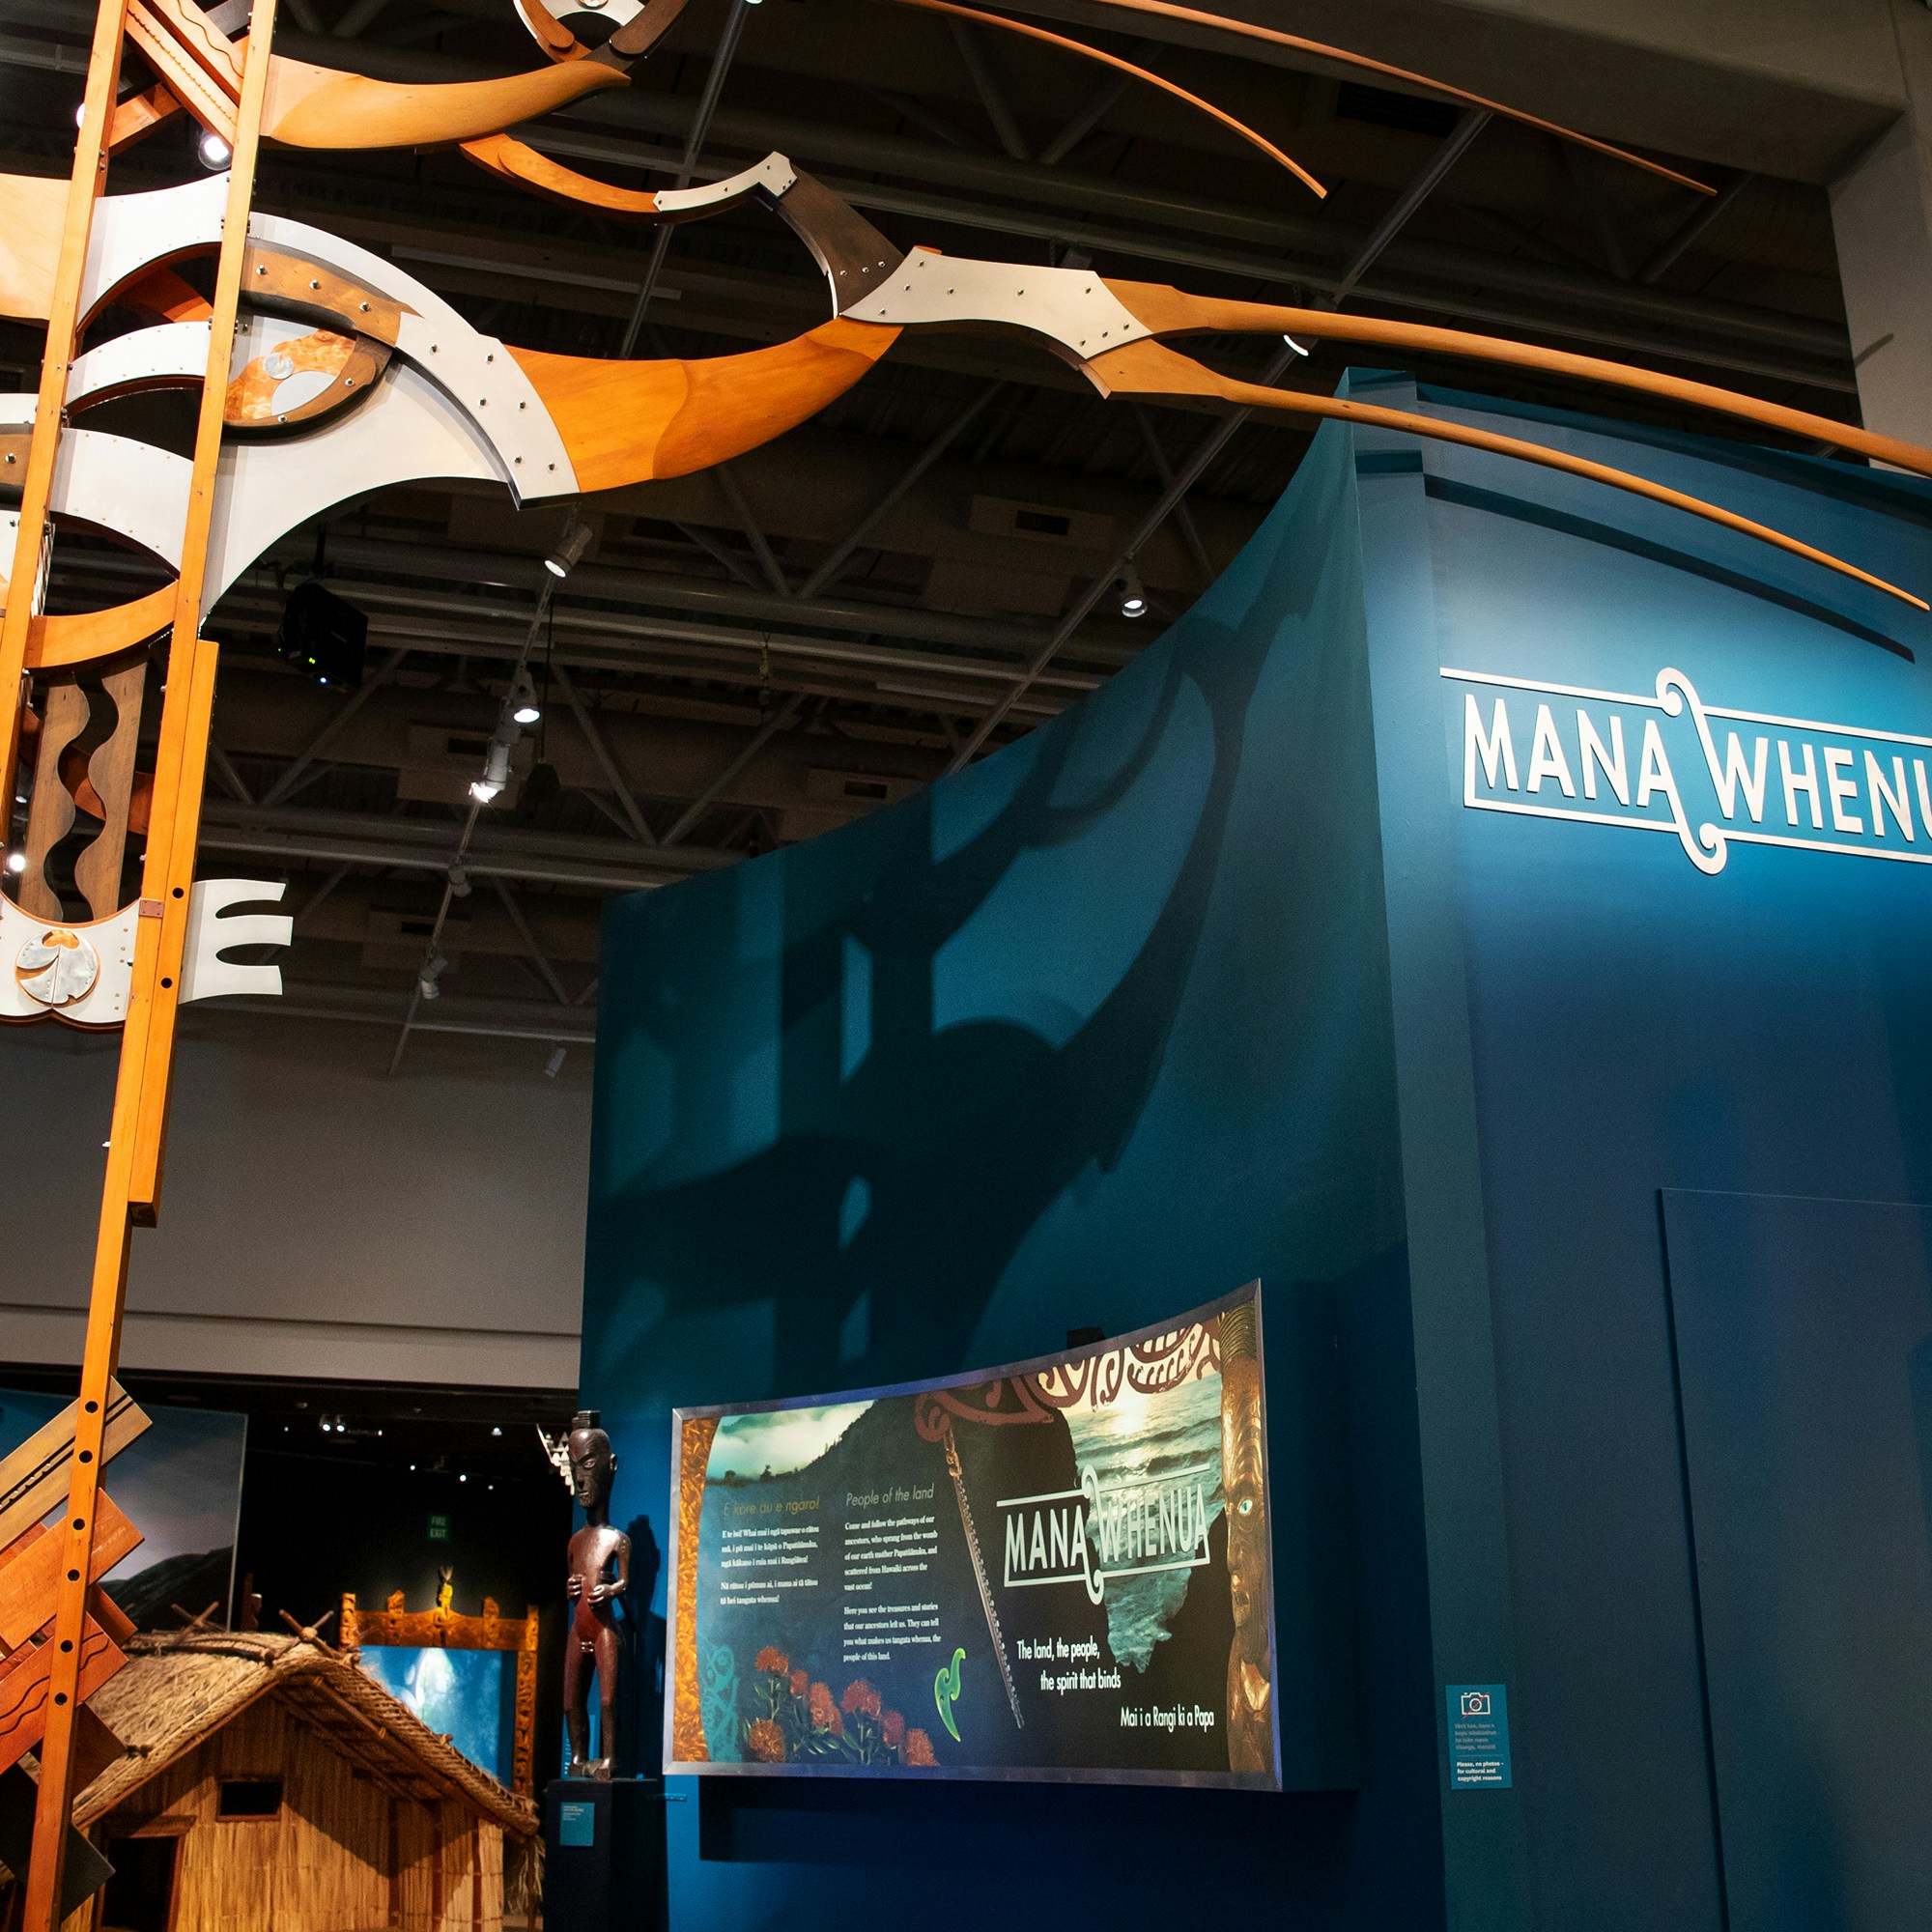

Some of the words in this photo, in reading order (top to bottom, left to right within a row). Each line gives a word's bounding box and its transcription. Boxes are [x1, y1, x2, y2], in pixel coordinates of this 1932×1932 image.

[1463, 692, 1681, 813] MANA
[846, 1490, 879, 1509] People
[882, 1487, 893, 1503] of
[895, 1487, 909, 1502] the
[912, 1483, 935, 1500] land
[734, 1500, 756, 1516] kore
[759, 1505, 773, 1514] au
[776, 1503, 782, 1513] e
[845, 1522, 861, 1530] Come
[861, 1520, 871, 1529] and
[871, 1520, 886, 1528] follow
[887, 1519, 896, 1527] the
[896, 1517, 919, 1527] pathways
[919, 1515, 926, 1524] of
[871, 1535, 882, 1543] who
[883, 1535, 900, 1544] sprang
[900, 1533, 913, 1541] from
[913, 1532, 922, 1540] the
[922, 1530, 938, 1539] womb
[1004, 1504, 1088, 1580] MANA
[1097, 1483, 1210, 1565] WHENUA
[844, 1552, 851, 1560] of
[860, 1551, 874, 1560] earth
[875, 1550, 894, 1558] mother
[928, 1546, 938, 1554] and
[844, 1566, 868, 1576] scattered
[868, 1566, 881, 1574] from
[881, 1564, 902, 1573] Hawaiki
[919, 1562, 928, 1570] the
[855, 1582, 872, 1590] ocean!
[844, 1606, 857, 1615] Here
[858, 1607, 868, 1615] you
[878, 1604, 887, 1613] the
[911, 1603, 921, 1611] and
[921, 1602, 938, 1611] stories
[844, 1622, 854, 1630] that
[865, 1621, 889, 1630] ancestors
[889, 1620, 898, 1628] left
[907, 1619, 920, 1628] They
[930, 1618, 939, 1626] tell
[854, 1637, 867, 1645] what
[867, 1636, 884, 1645] makes
[892, 1636, 911, 1645] tangata
[911, 1634, 932, 1643] whenua,
[932, 1634, 942, 1642] the
[1016, 1640, 1033, 1660] The
[1034, 1637, 1055, 1662] land,
[1056, 1636, 1069, 1659] the
[1070, 1634, 1100, 1663] people,
[843, 1652, 861, 1662] people
[861, 1652, 867, 1660] of
[867, 1652, 878, 1661] this
[878, 1651, 891, 1660] land.
[1040, 1670, 1055, 1690] the
[1056, 1670, 1079, 1695] spirit
[1079, 1669, 1097, 1690] that
[1097, 1667, 1122, 1689] binds
[1121, 1706, 1138, 1727] Mai
[1139, 1708, 1143, 1726] i
[1145, 1714, 1152, 1726] a
[1153, 1705, 1176, 1733] Rangi
[1178, 1704, 1185, 1726] ki
[1187, 1713, 1193, 1726] a
[1194, 1705, 1215, 1733] Papa
